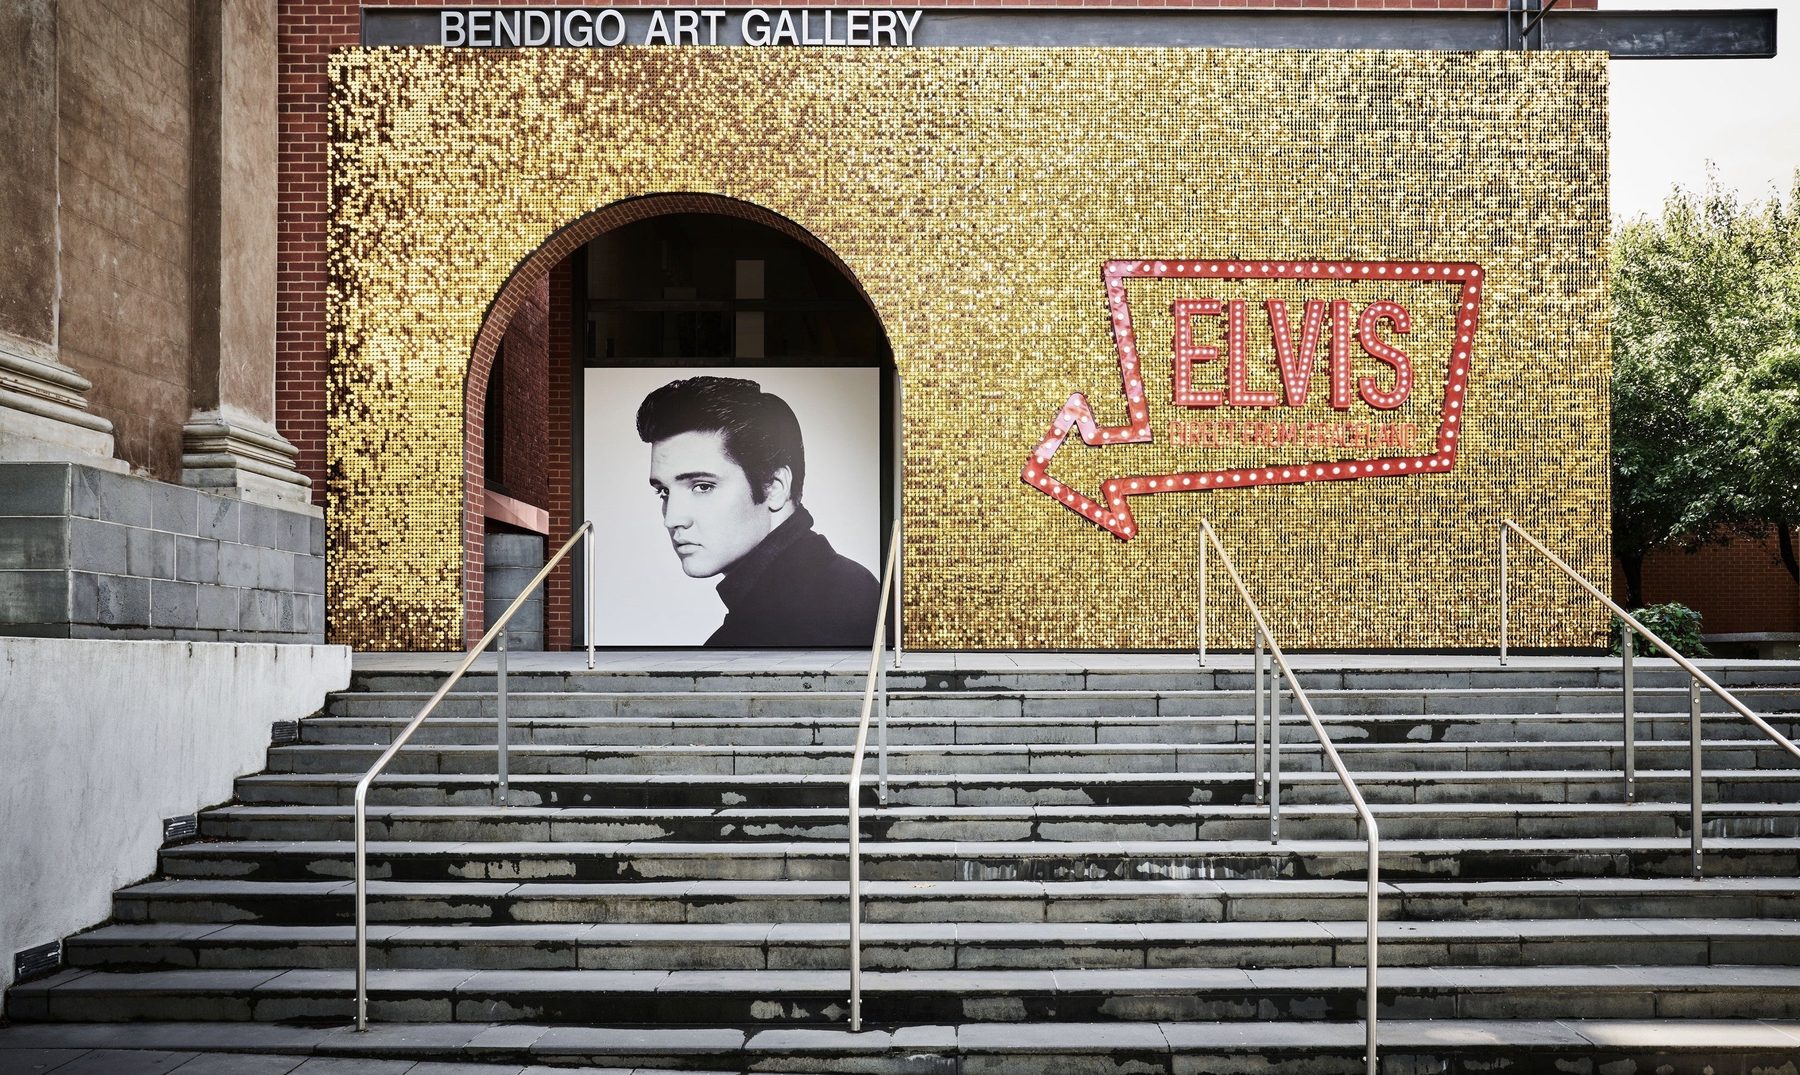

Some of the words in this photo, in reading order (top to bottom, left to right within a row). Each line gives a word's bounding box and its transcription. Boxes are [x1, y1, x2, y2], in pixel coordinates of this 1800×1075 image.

[440, 9, 626, 47] BENDIGO
[645, 10, 726, 46] ART
[741, 10, 922, 47] GALLERY
[1174, 298, 1413, 409] ELVIS
[1169, 421, 1235, 448] DIRECT
[1241, 421, 1298, 448] FROM
[1302, 421, 1417, 449] GRACELAND
